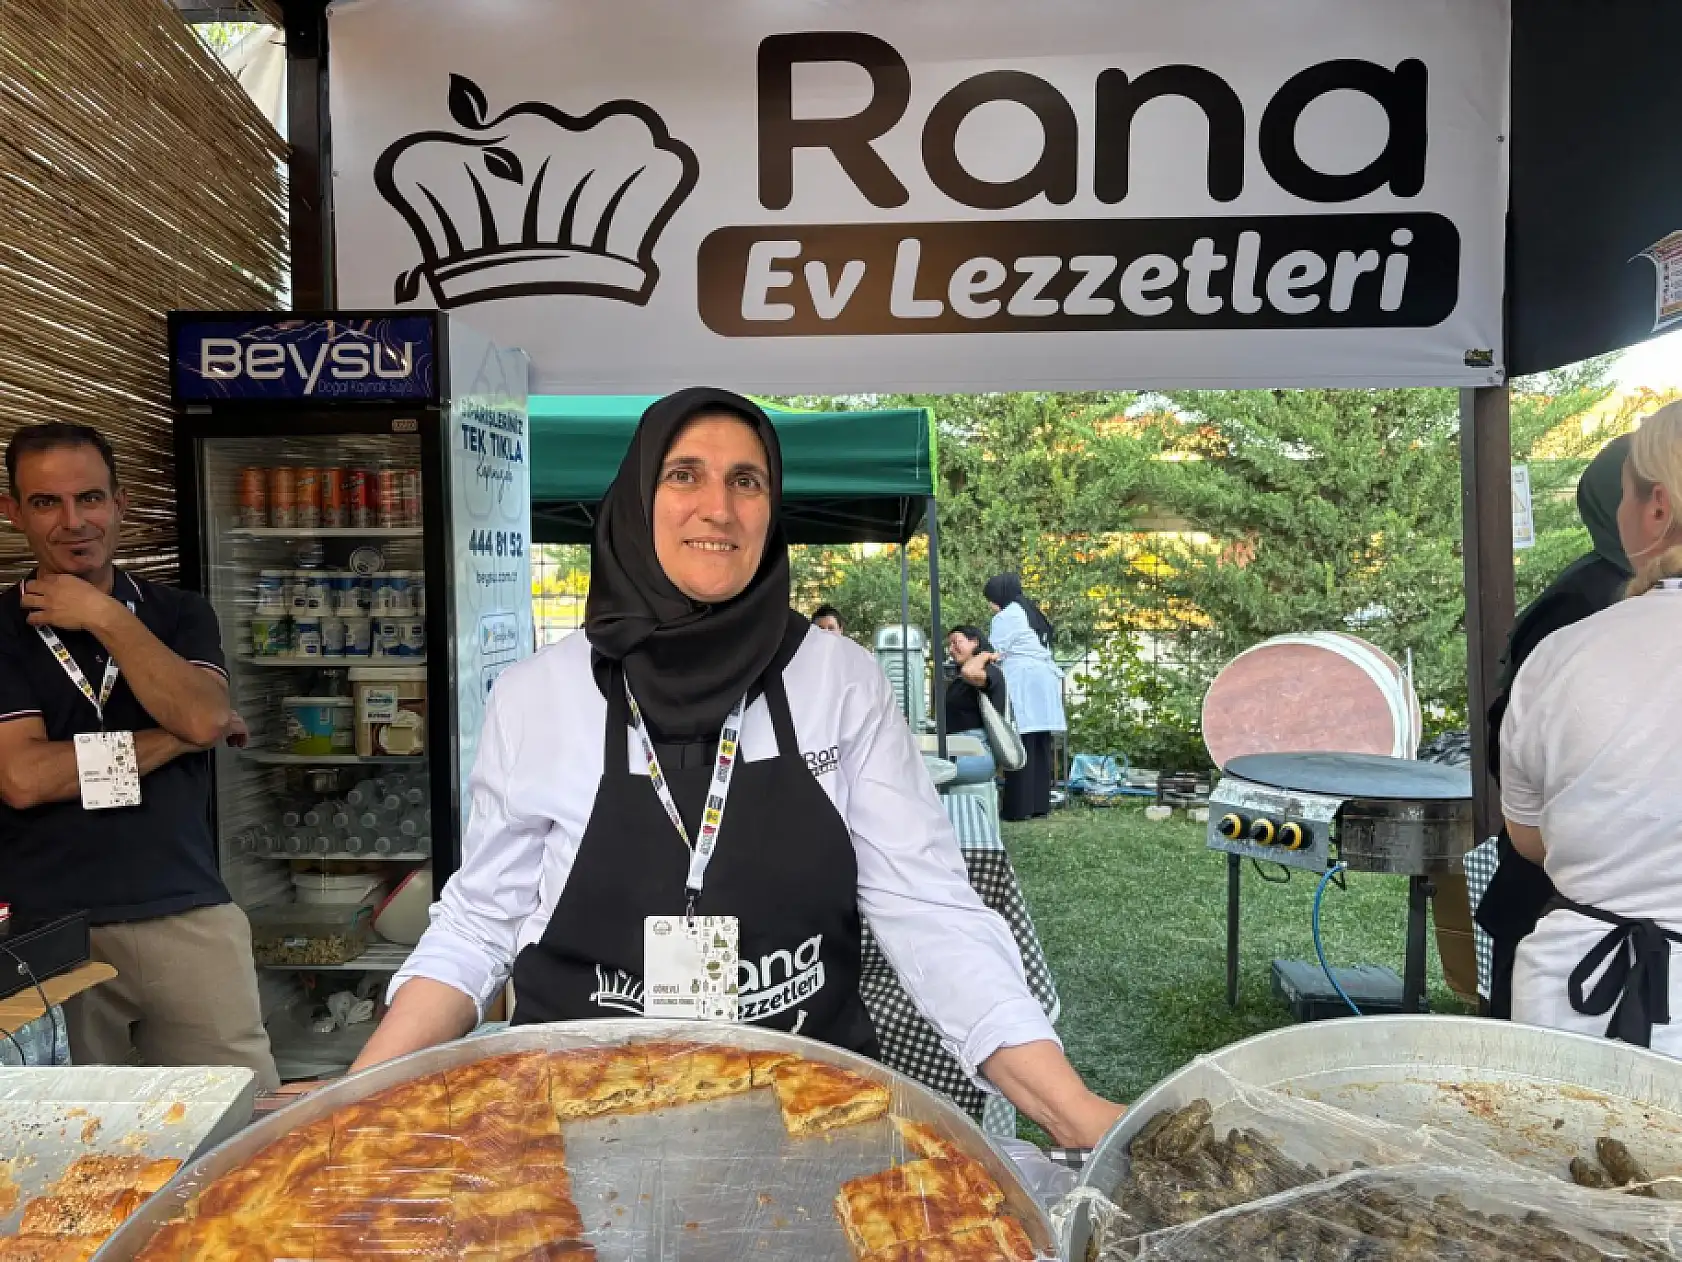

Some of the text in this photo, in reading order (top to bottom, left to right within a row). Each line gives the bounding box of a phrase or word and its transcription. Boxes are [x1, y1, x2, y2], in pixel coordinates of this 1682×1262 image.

[757, 31, 1428, 210] Rana
[741, 228, 1414, 321] Ev Lezzetleri
[461, 422, 524, 464] TEK TIKLA
[468, 528, 523, 558] 444 81 52
[738, 933, 824, 995] ana
